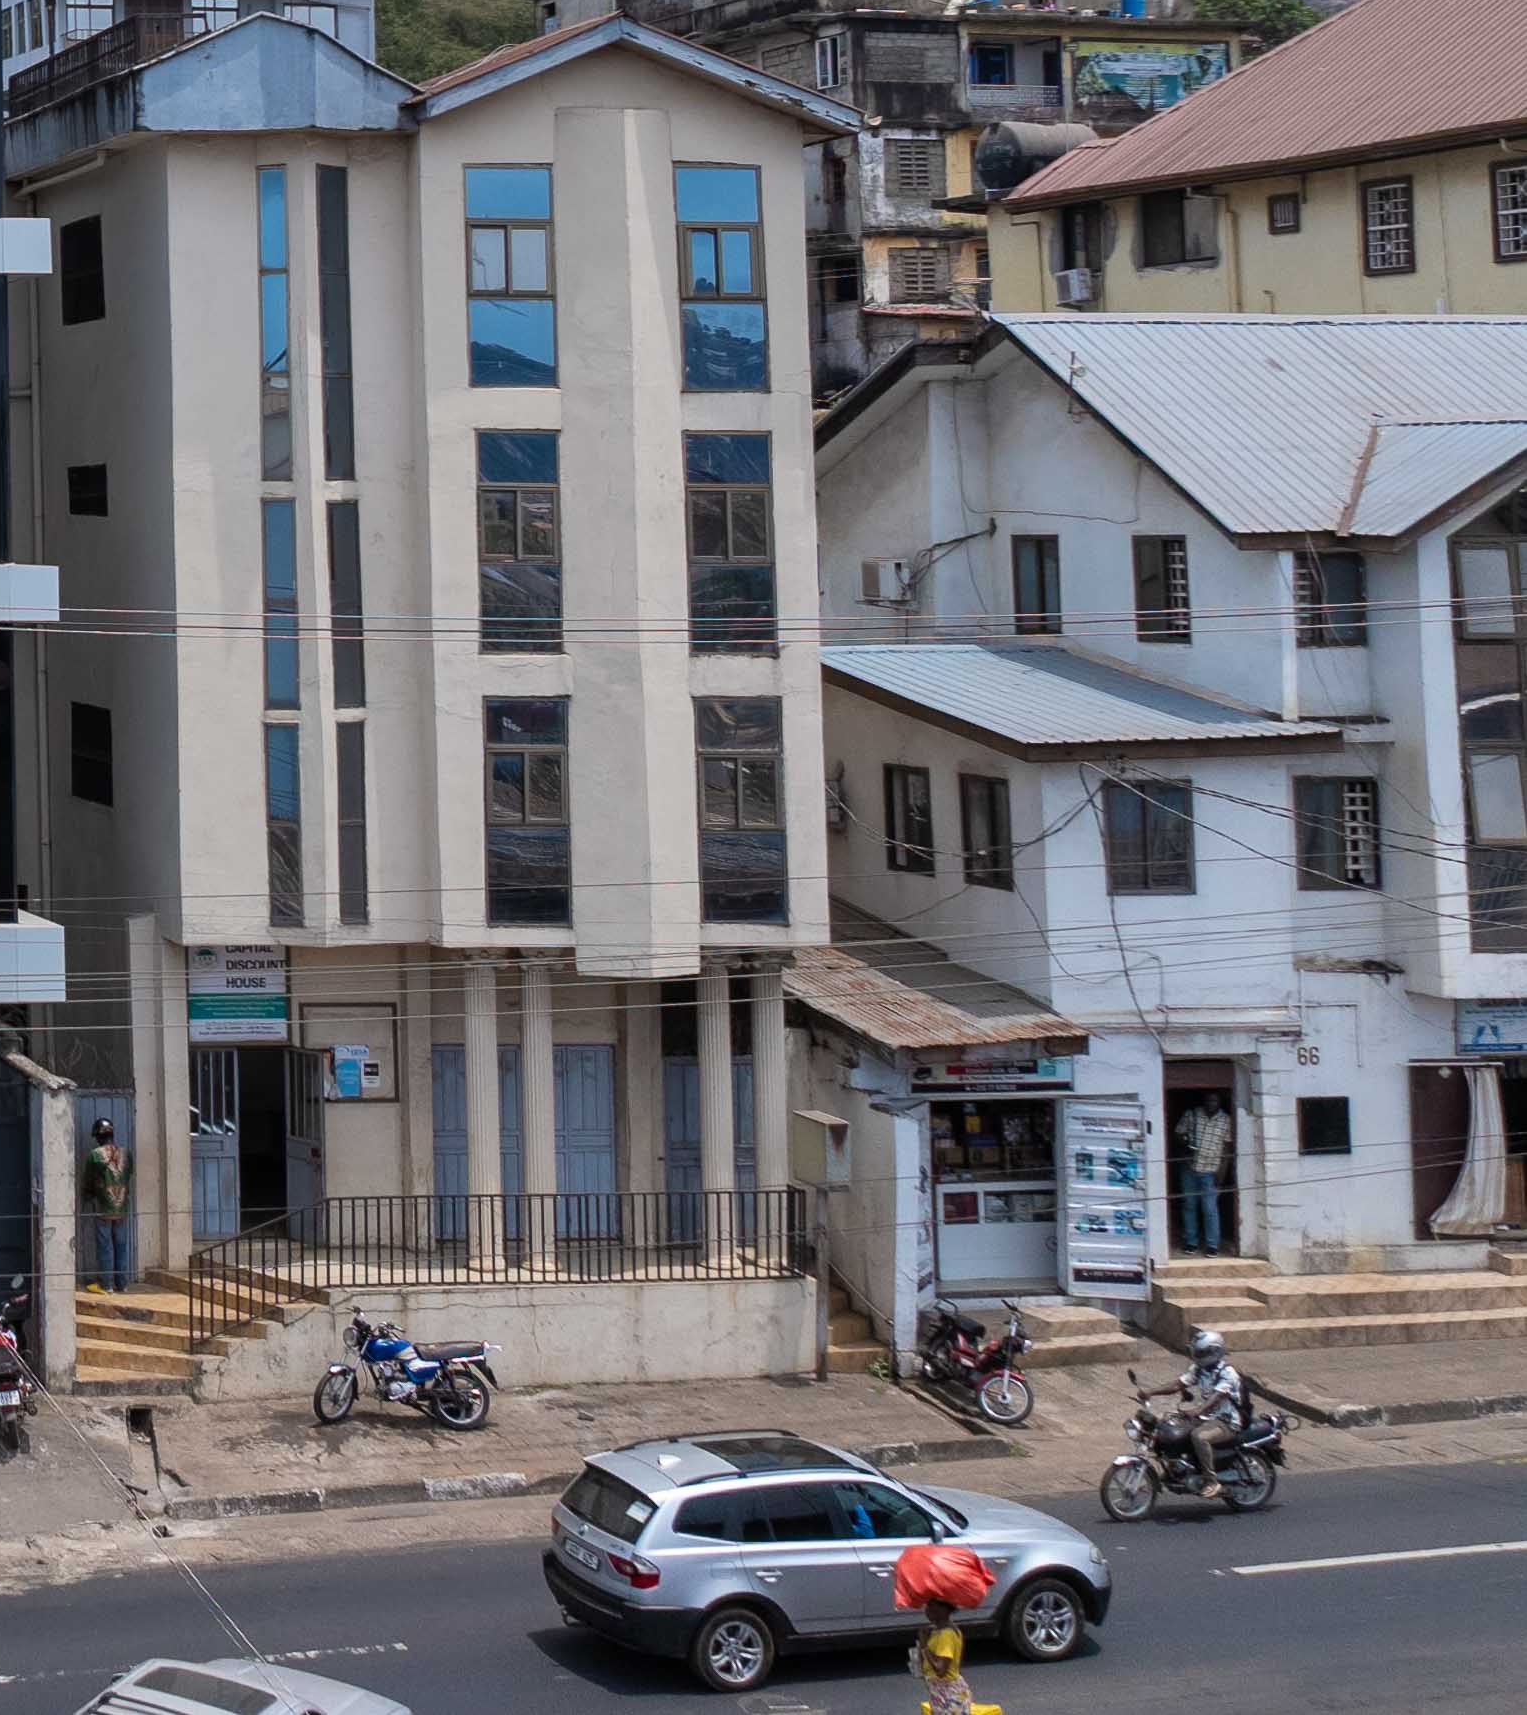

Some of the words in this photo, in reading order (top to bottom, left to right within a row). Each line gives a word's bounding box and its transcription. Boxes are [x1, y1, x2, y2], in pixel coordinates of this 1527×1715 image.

[225, 945, 274, 954] CAPITAL
[225, 959, 286, 971] DISCOUNT
[225, 977, 266, 989] HOUSE
[1297, 1046, 1320, 1066] 66
